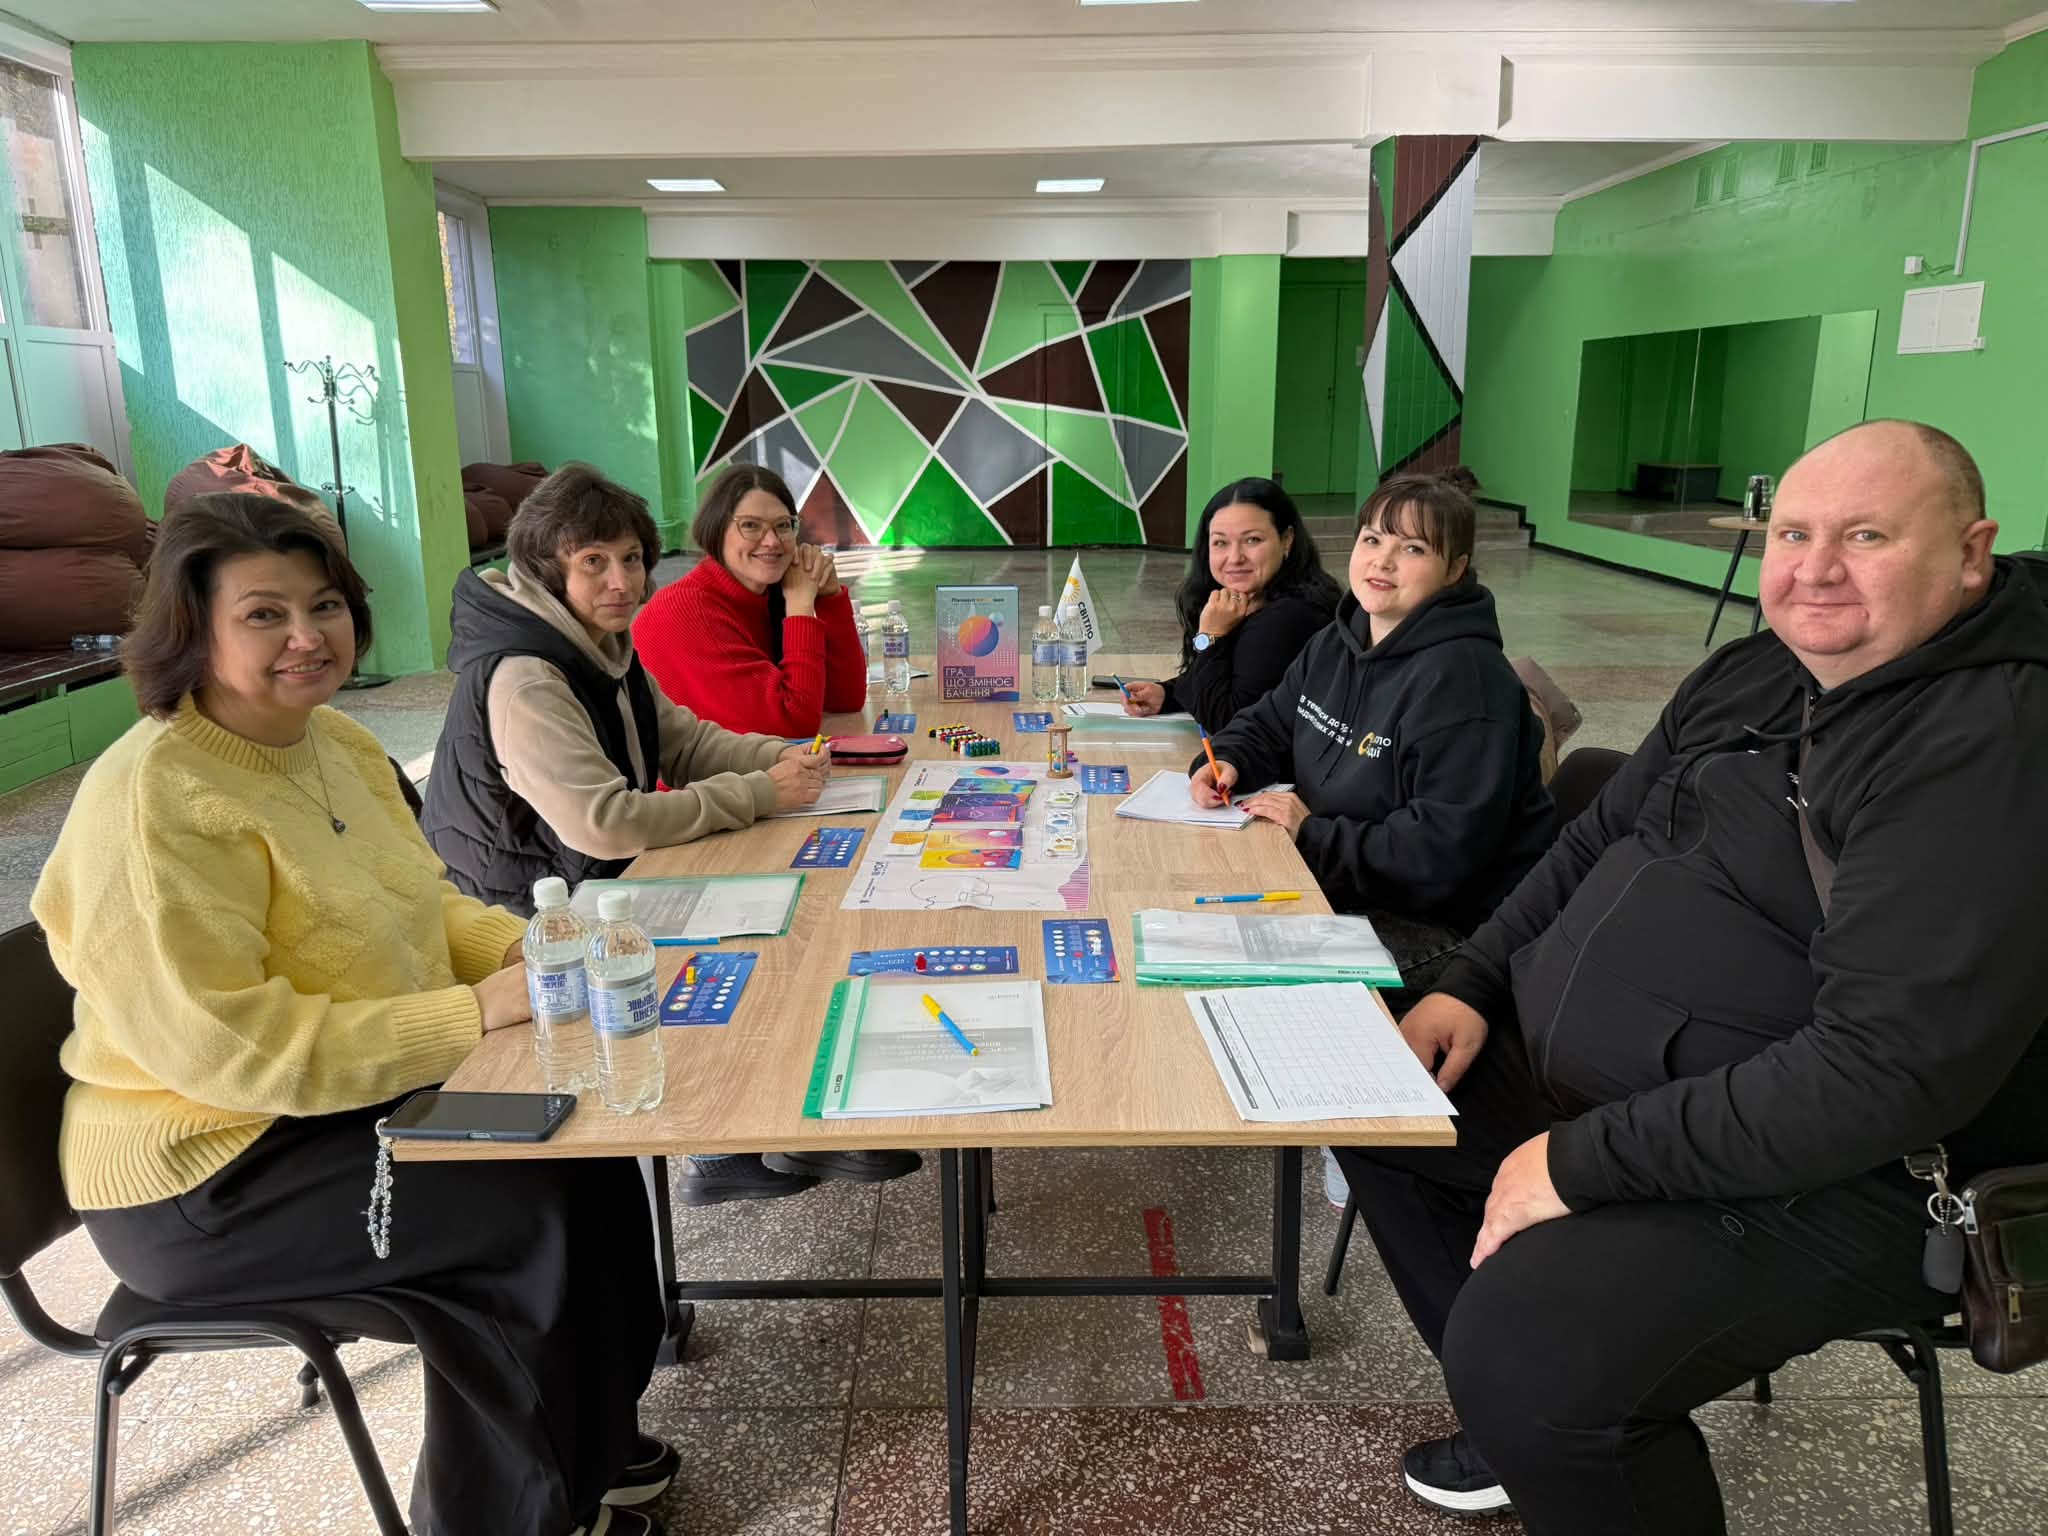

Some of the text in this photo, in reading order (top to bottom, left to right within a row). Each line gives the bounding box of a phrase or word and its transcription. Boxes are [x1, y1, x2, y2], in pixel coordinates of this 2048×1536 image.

[945, 677, 1013, 688] ЩО ЗМІНЮЄ
[946, 688, 990, 698] БАЧЕННЯ
